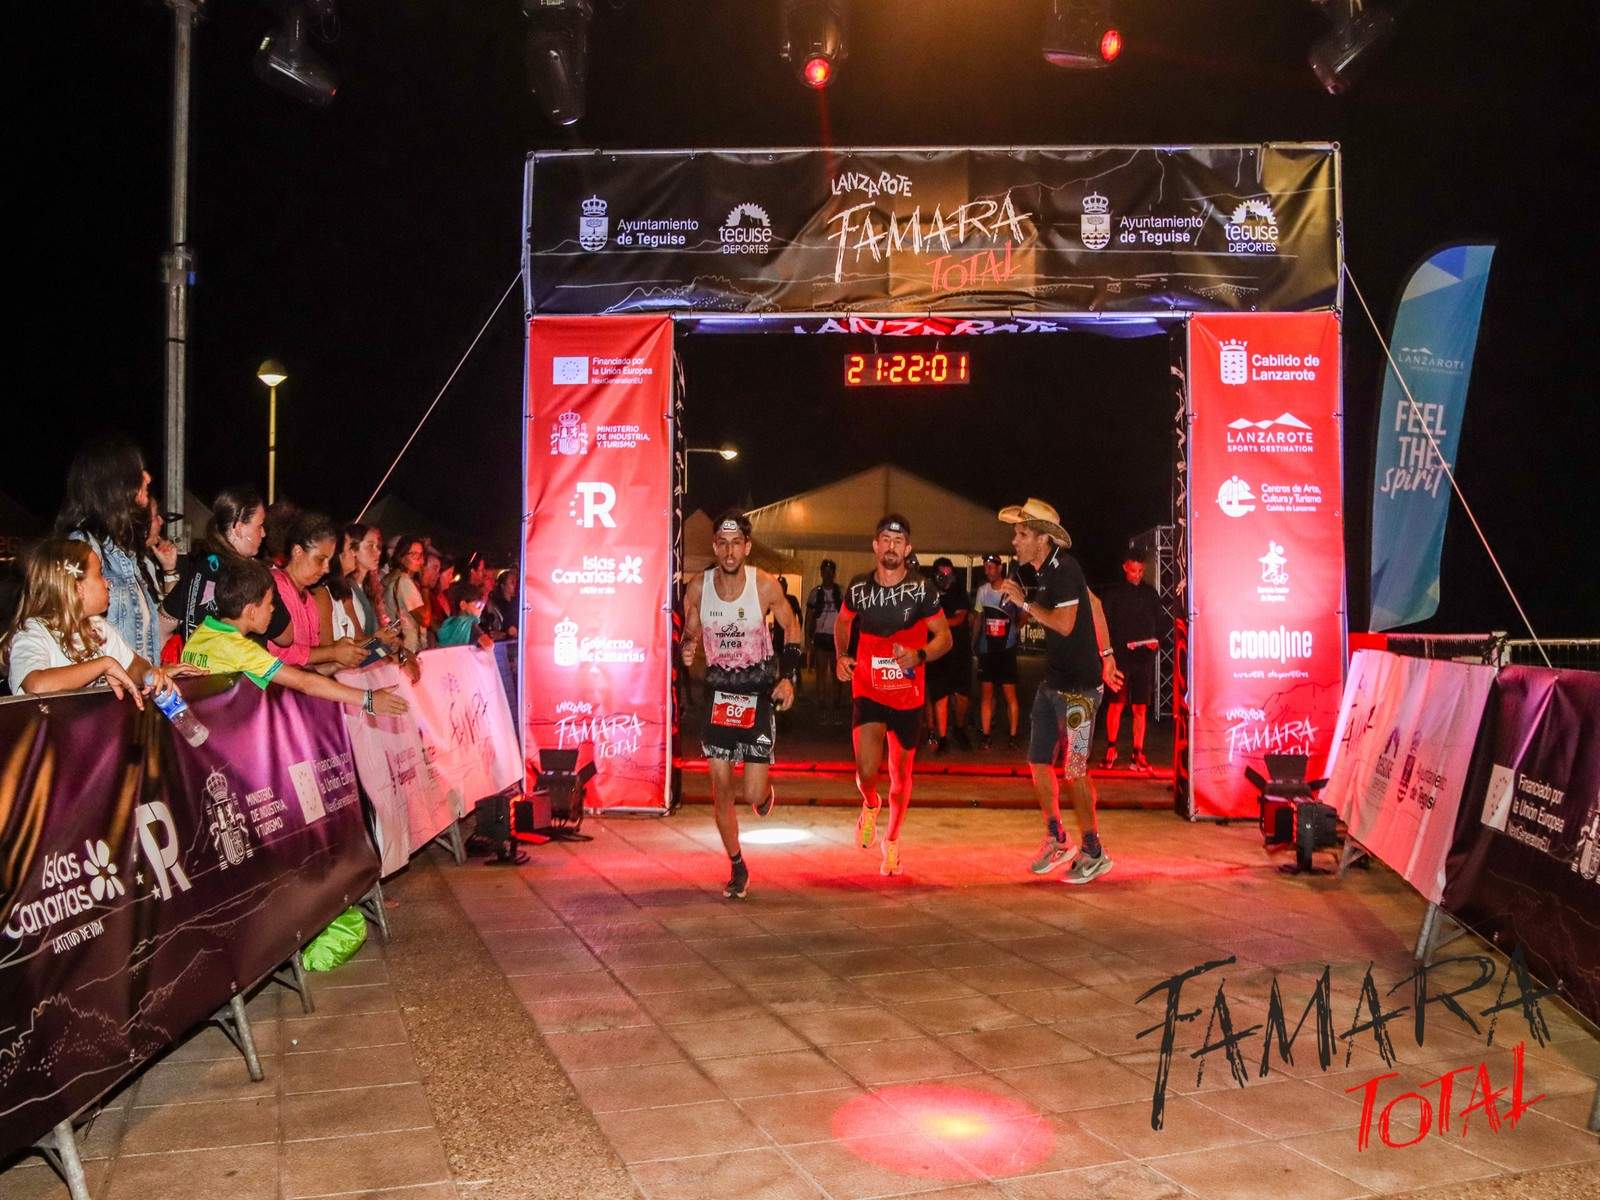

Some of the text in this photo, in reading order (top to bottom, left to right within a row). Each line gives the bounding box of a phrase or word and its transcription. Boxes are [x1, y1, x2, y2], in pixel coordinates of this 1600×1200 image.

[831, 171, 912, 198] LANZAROTE
[617, 218, 699, 232] Ayuntamiento
[1119, 215, 1204, 231] Ayuntamiento
[617, 232, 686, 248] de Teguise
[827, 190, 1033, 284] FAMARA
[1119, 230, 1191, 246] de Teguise
[722, 244, 769, 255] DEPORTES
[1228, 242, 1277, 253] DEPORTES
[926, 239, 1021, 293] TOTAL
[592, 357, 645, 367] Financiado por
[1251, 353, 1321, 367] Cabildo de
[592, 366, 653, 377] la Unión Europea
[847, 355, 966, 383] 21:22:01
[1252, 368, 1316, 381] Lanzarote
[1395, 400, 1448, 436] FEEL
[596, 425, 640, 433] MINISTERIO
[1227, 431, 1314, 443] LANZAROTE
[596, 433, 651, 442] DE INDUSTRIA,
[596, 441, 637, 449] Y TURISMO
[1227, 445, 1314, 453] SPORTS DESTINATION
[1399, 436, 1442, 470] THE
[1261, 483, 1291, 493] Centros
[1292, 483, 1302, 493] de
[1380, 463, 1452, 500] spirit
[1261, 494, 1322, 504] Cultura y Turismo
[583, 556, 616, 569] Islas
[551, 568, 616, 584] Canarias
[850, 580, 927, 611] FAMARA
[580, 637, 634, 650] Gobierno
[719, 640, 742, 649] Area
[726, 705, 743, 718] 60
[554, 712, 646, 750] FAMARA
[600, 735, 641, 759] TOTAL
[1225, 716, 1319, 764] FAMARA
[245, 786, 275, 807] MINISTERIO
[1519, 799, 1538, 821] Unión
[1537, 806, 1565, 834] Europea
[260, 816, 284, 837] TURISMO
[41, 851, 81, 890] Islas
[3, 884, 94, 939] Canarias
